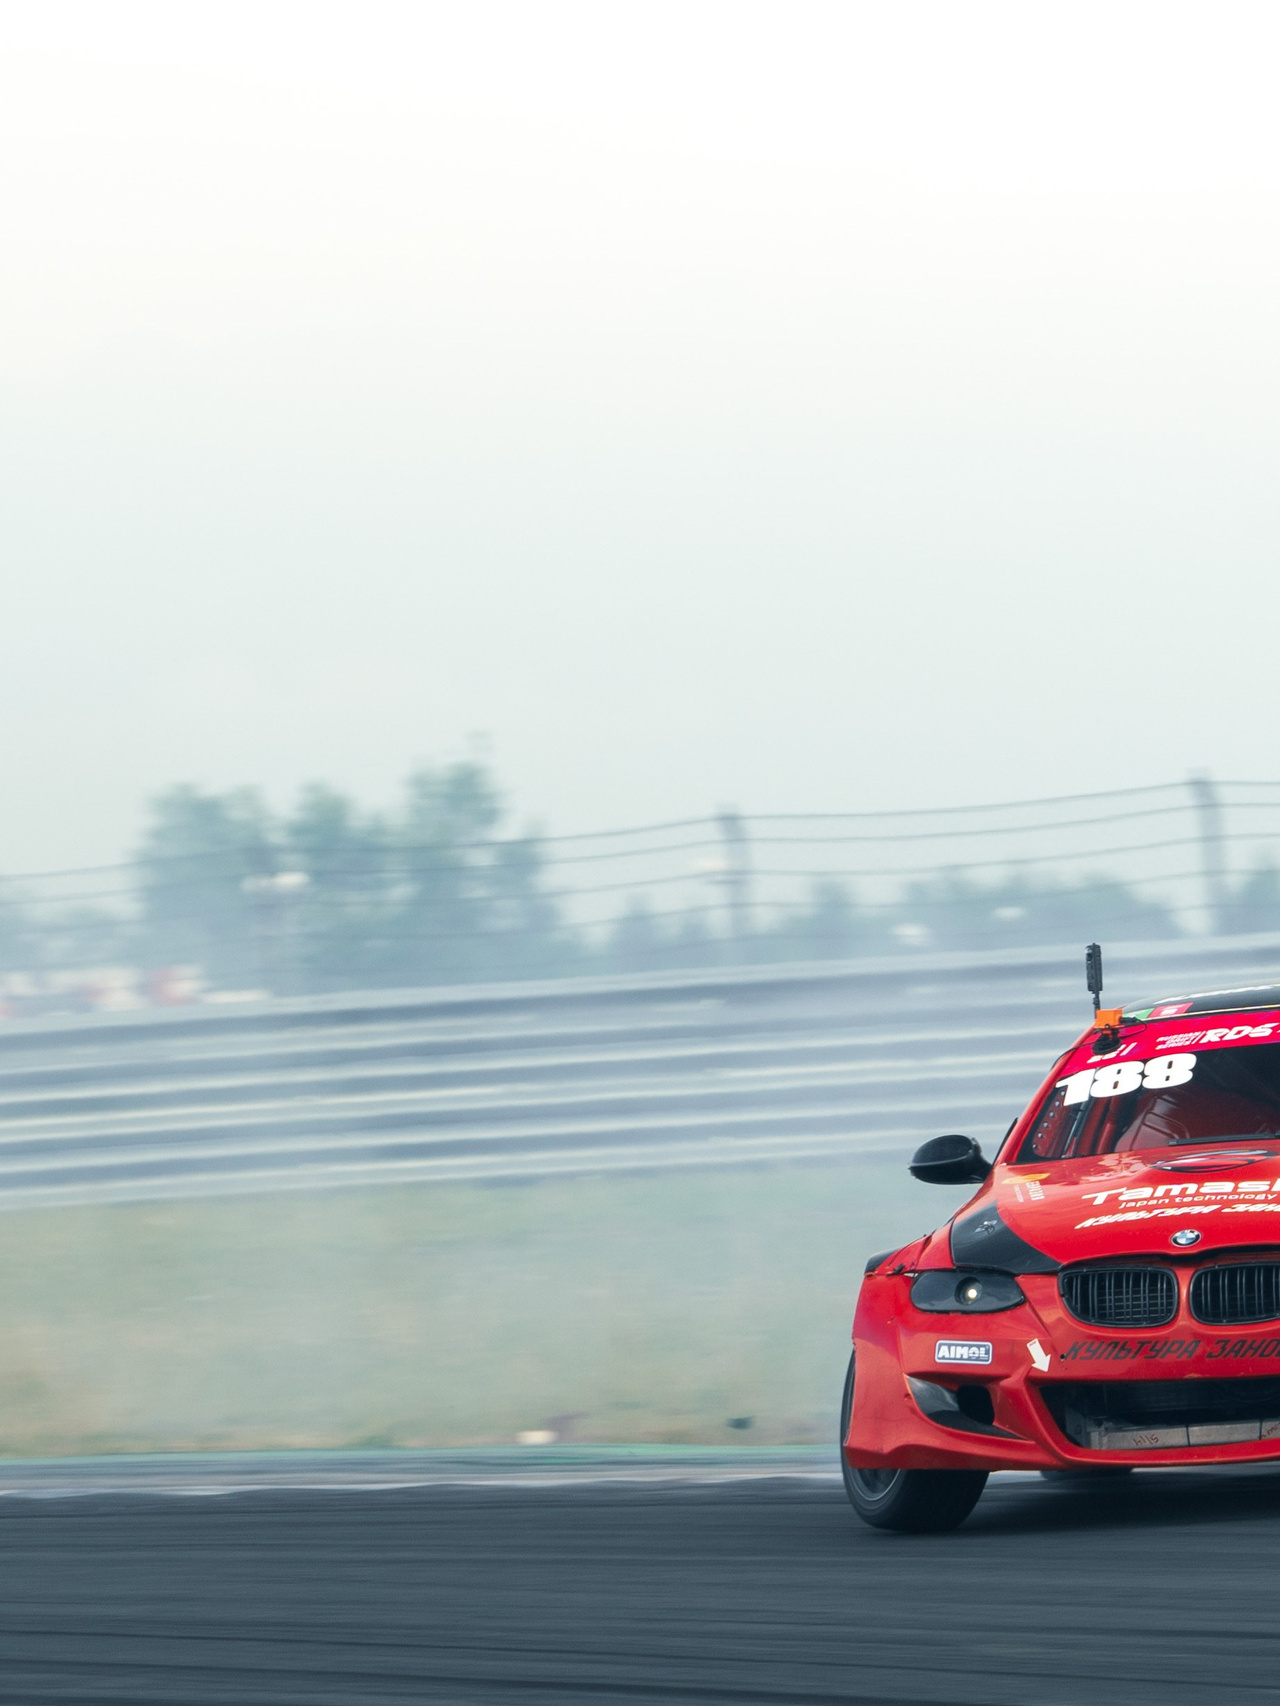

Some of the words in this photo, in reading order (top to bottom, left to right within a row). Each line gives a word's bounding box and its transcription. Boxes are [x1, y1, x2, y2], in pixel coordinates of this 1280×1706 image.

[1200, 1022, 1279, 1043] RDS
[1056, 1053, 1197, 1106] 188
[1118, 1198, 1170, 1209] japan
[1175, 1193, 1278, 1204] technology
[938, 1345, 989, 1359] AIMOL
[1064, 1340, 1201, 1360] КУЛЬТУРА
